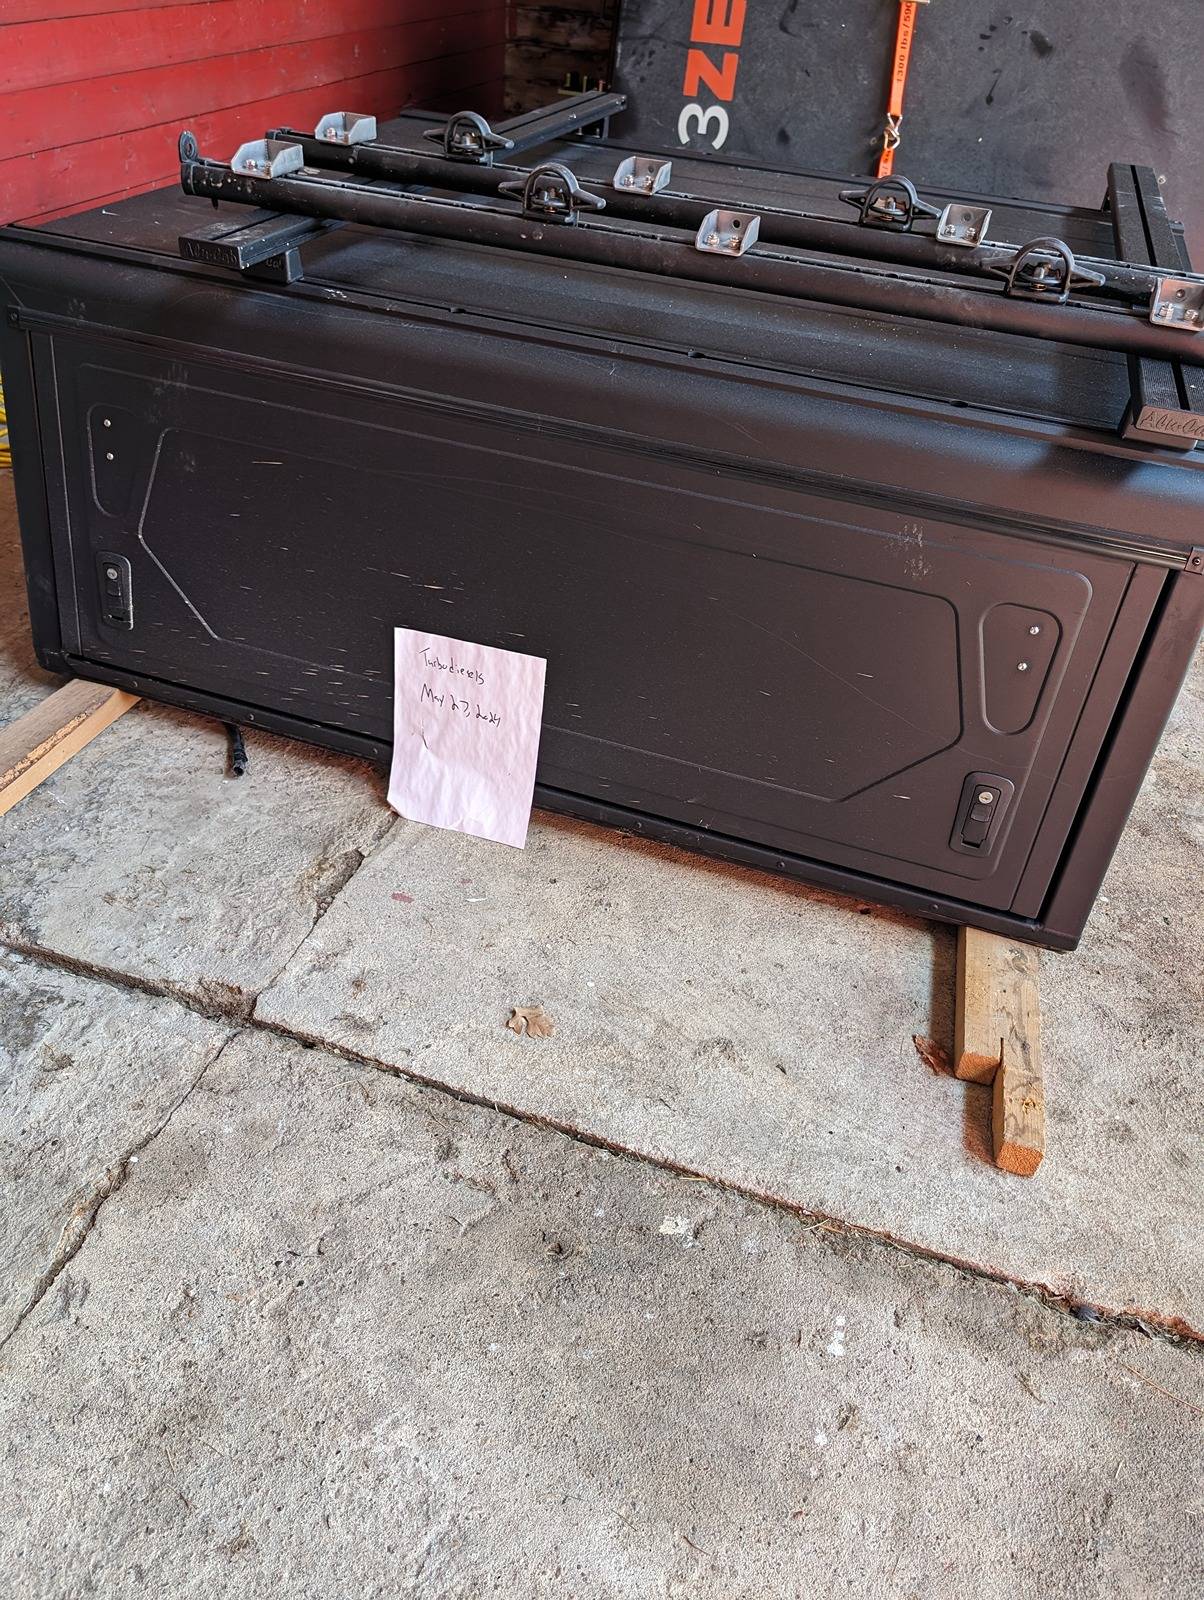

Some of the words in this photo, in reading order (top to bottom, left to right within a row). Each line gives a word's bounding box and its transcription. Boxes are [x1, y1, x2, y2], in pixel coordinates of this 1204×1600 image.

[895, 54, 906, 82] 1300
[420, 683, 445, 707] May
[450, 694, 471, 718] 27,
[475, 704, 501, 728] 2024
